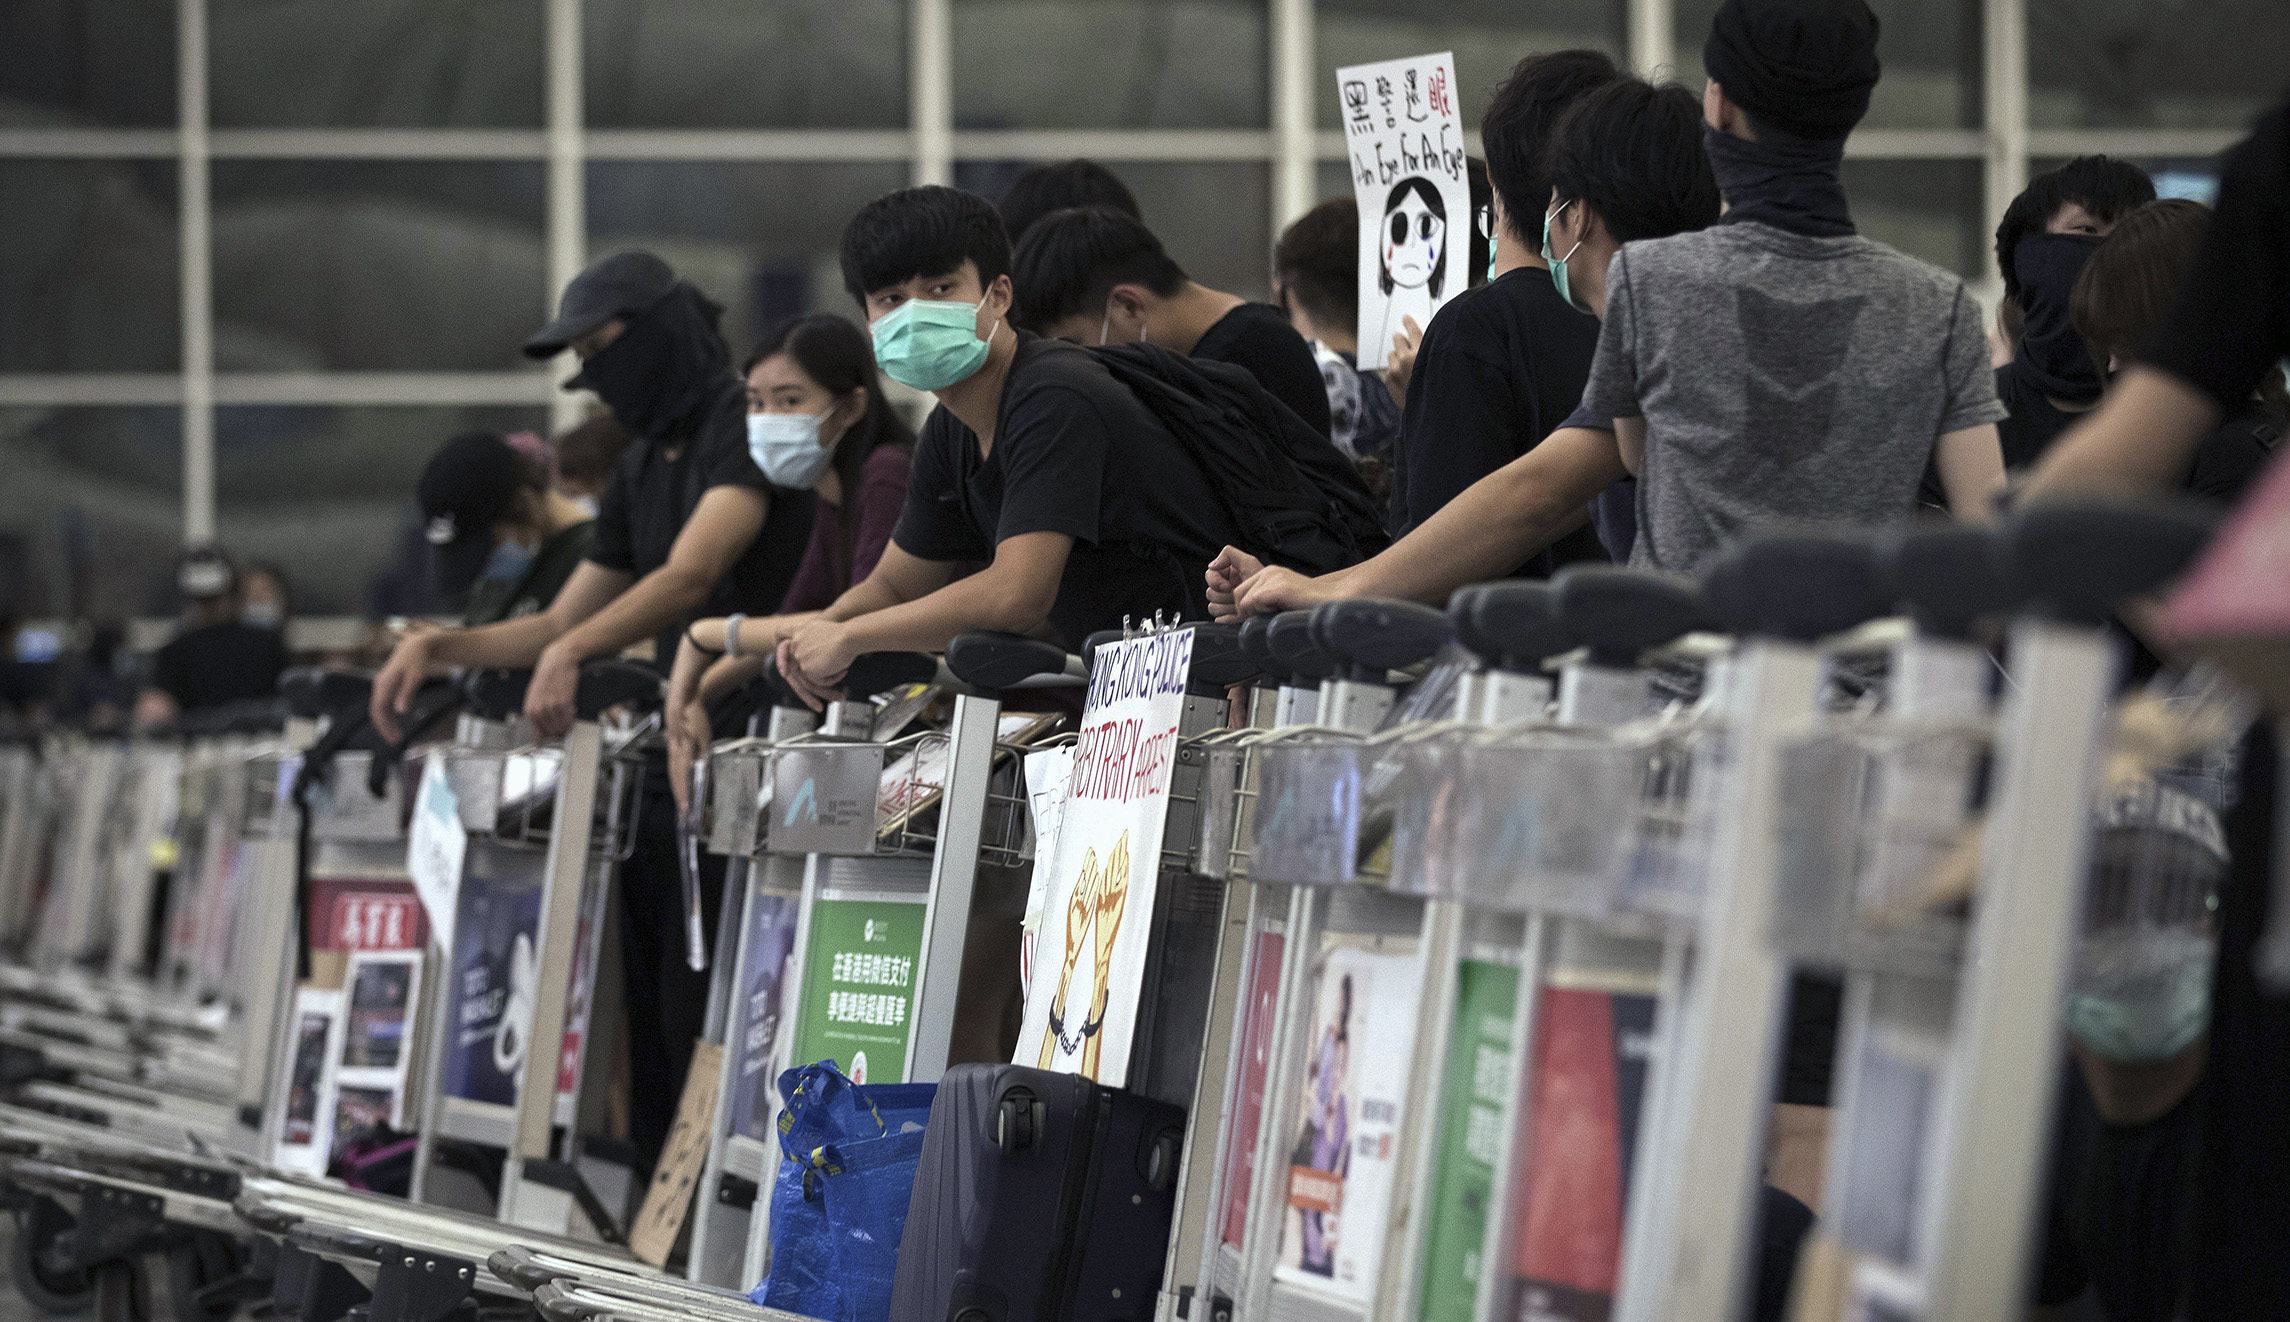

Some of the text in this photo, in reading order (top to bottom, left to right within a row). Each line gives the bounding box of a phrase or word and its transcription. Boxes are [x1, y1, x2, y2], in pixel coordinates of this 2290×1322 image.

[1375, 142, 1400, 186] Eye
[1421, 132, 1442, 172] An
[1440, 123, 1464, 182] Eye
[1083, 630, 1193, 714] HONG KONG POLICE
[1067, 718, 1177, 804] ARBITRARY ARREST
